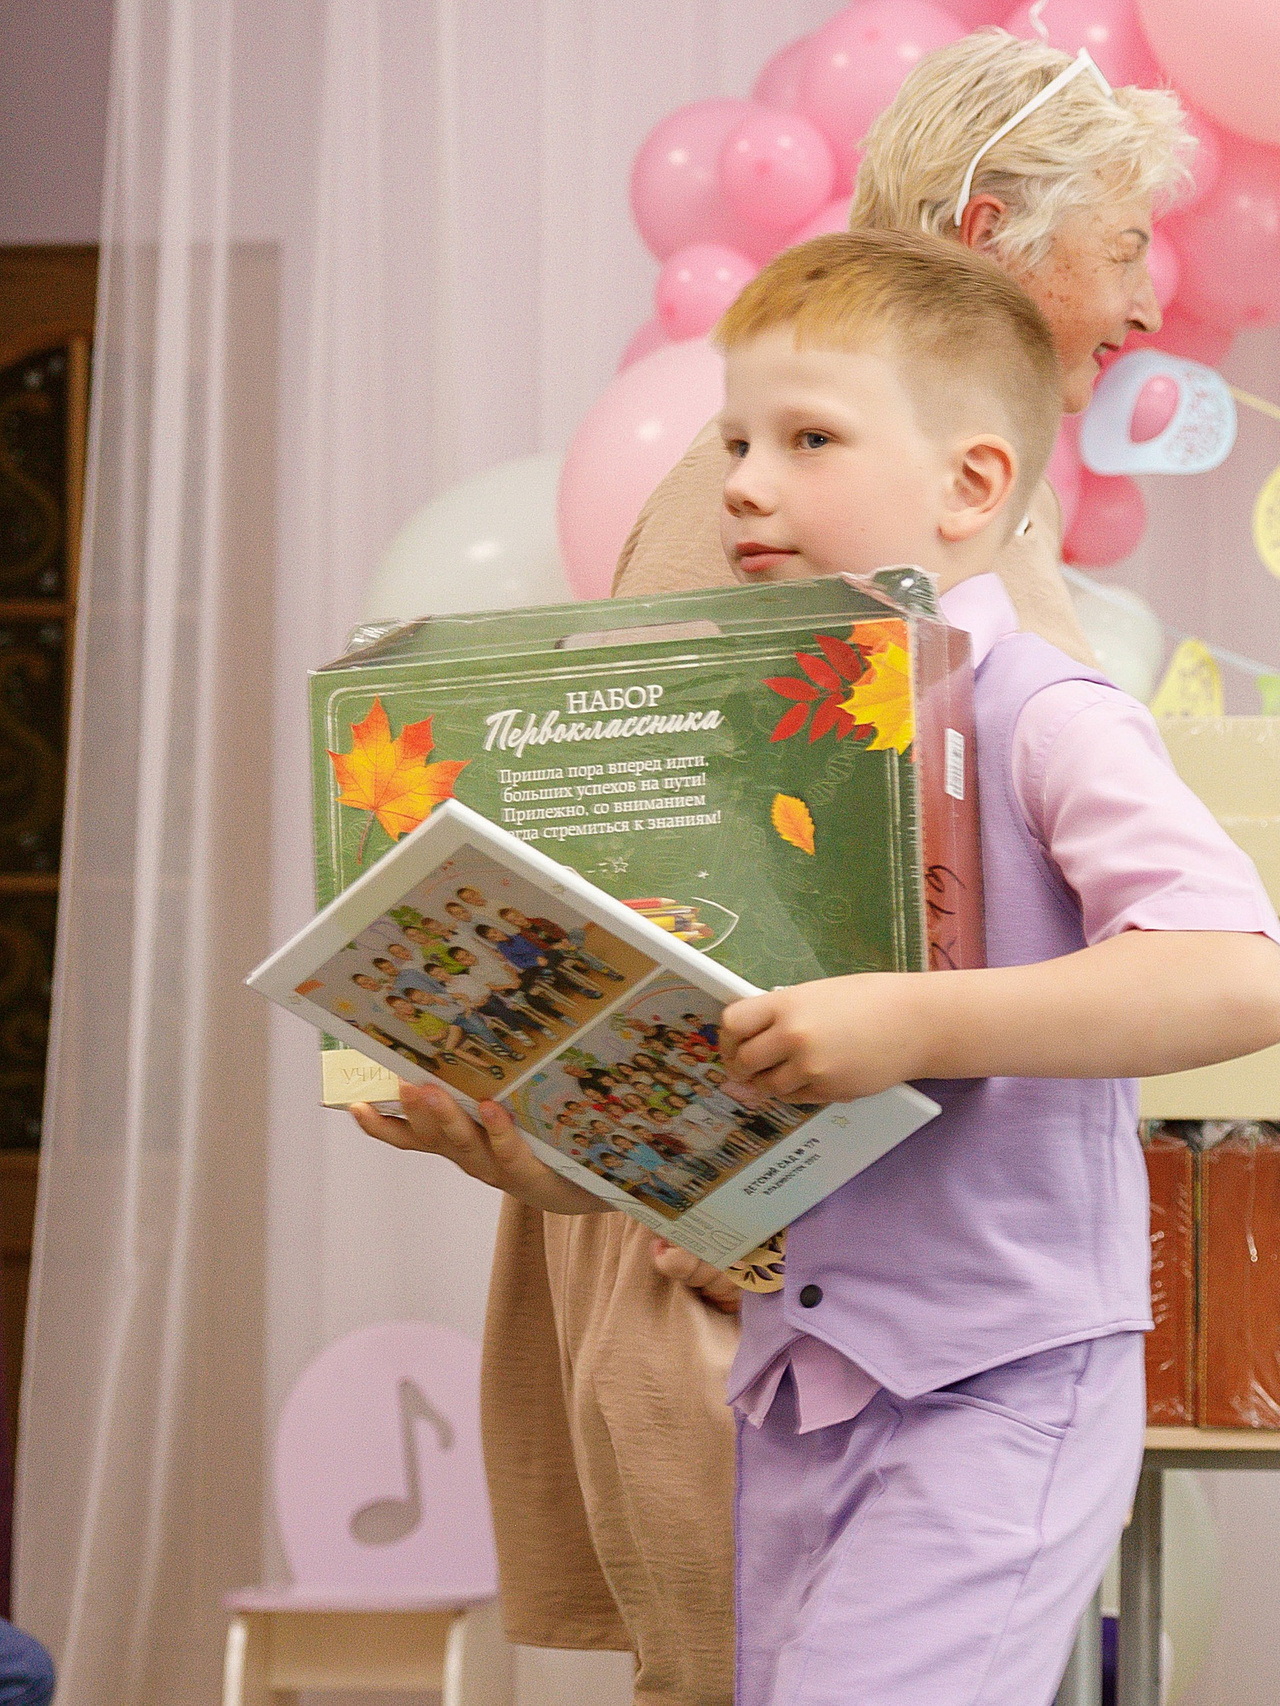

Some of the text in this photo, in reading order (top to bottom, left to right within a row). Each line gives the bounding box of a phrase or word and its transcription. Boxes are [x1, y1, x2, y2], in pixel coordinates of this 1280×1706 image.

[566, 684, 664, 714] НАБОР
[483, 709, 725, 758] Первоклассника
[497, 768, 564, 786] Пришла
[566, 763, 604, 781] пора
[607, 757, 662, 776] вперед
[503, 772, 707, 804] больших успехов на пути!
[593, 803, 610, 815] со
[614, 794, 706, 813] вниманием
[543, 821, 630, 841] стремиться
[632, 819, 645, 831] к
[645, 810, 721, 830] знаниям!
[743, 1166, 778, 1196] ДЕТСКИЙ
[777, 1155, 799, 1169] САД
